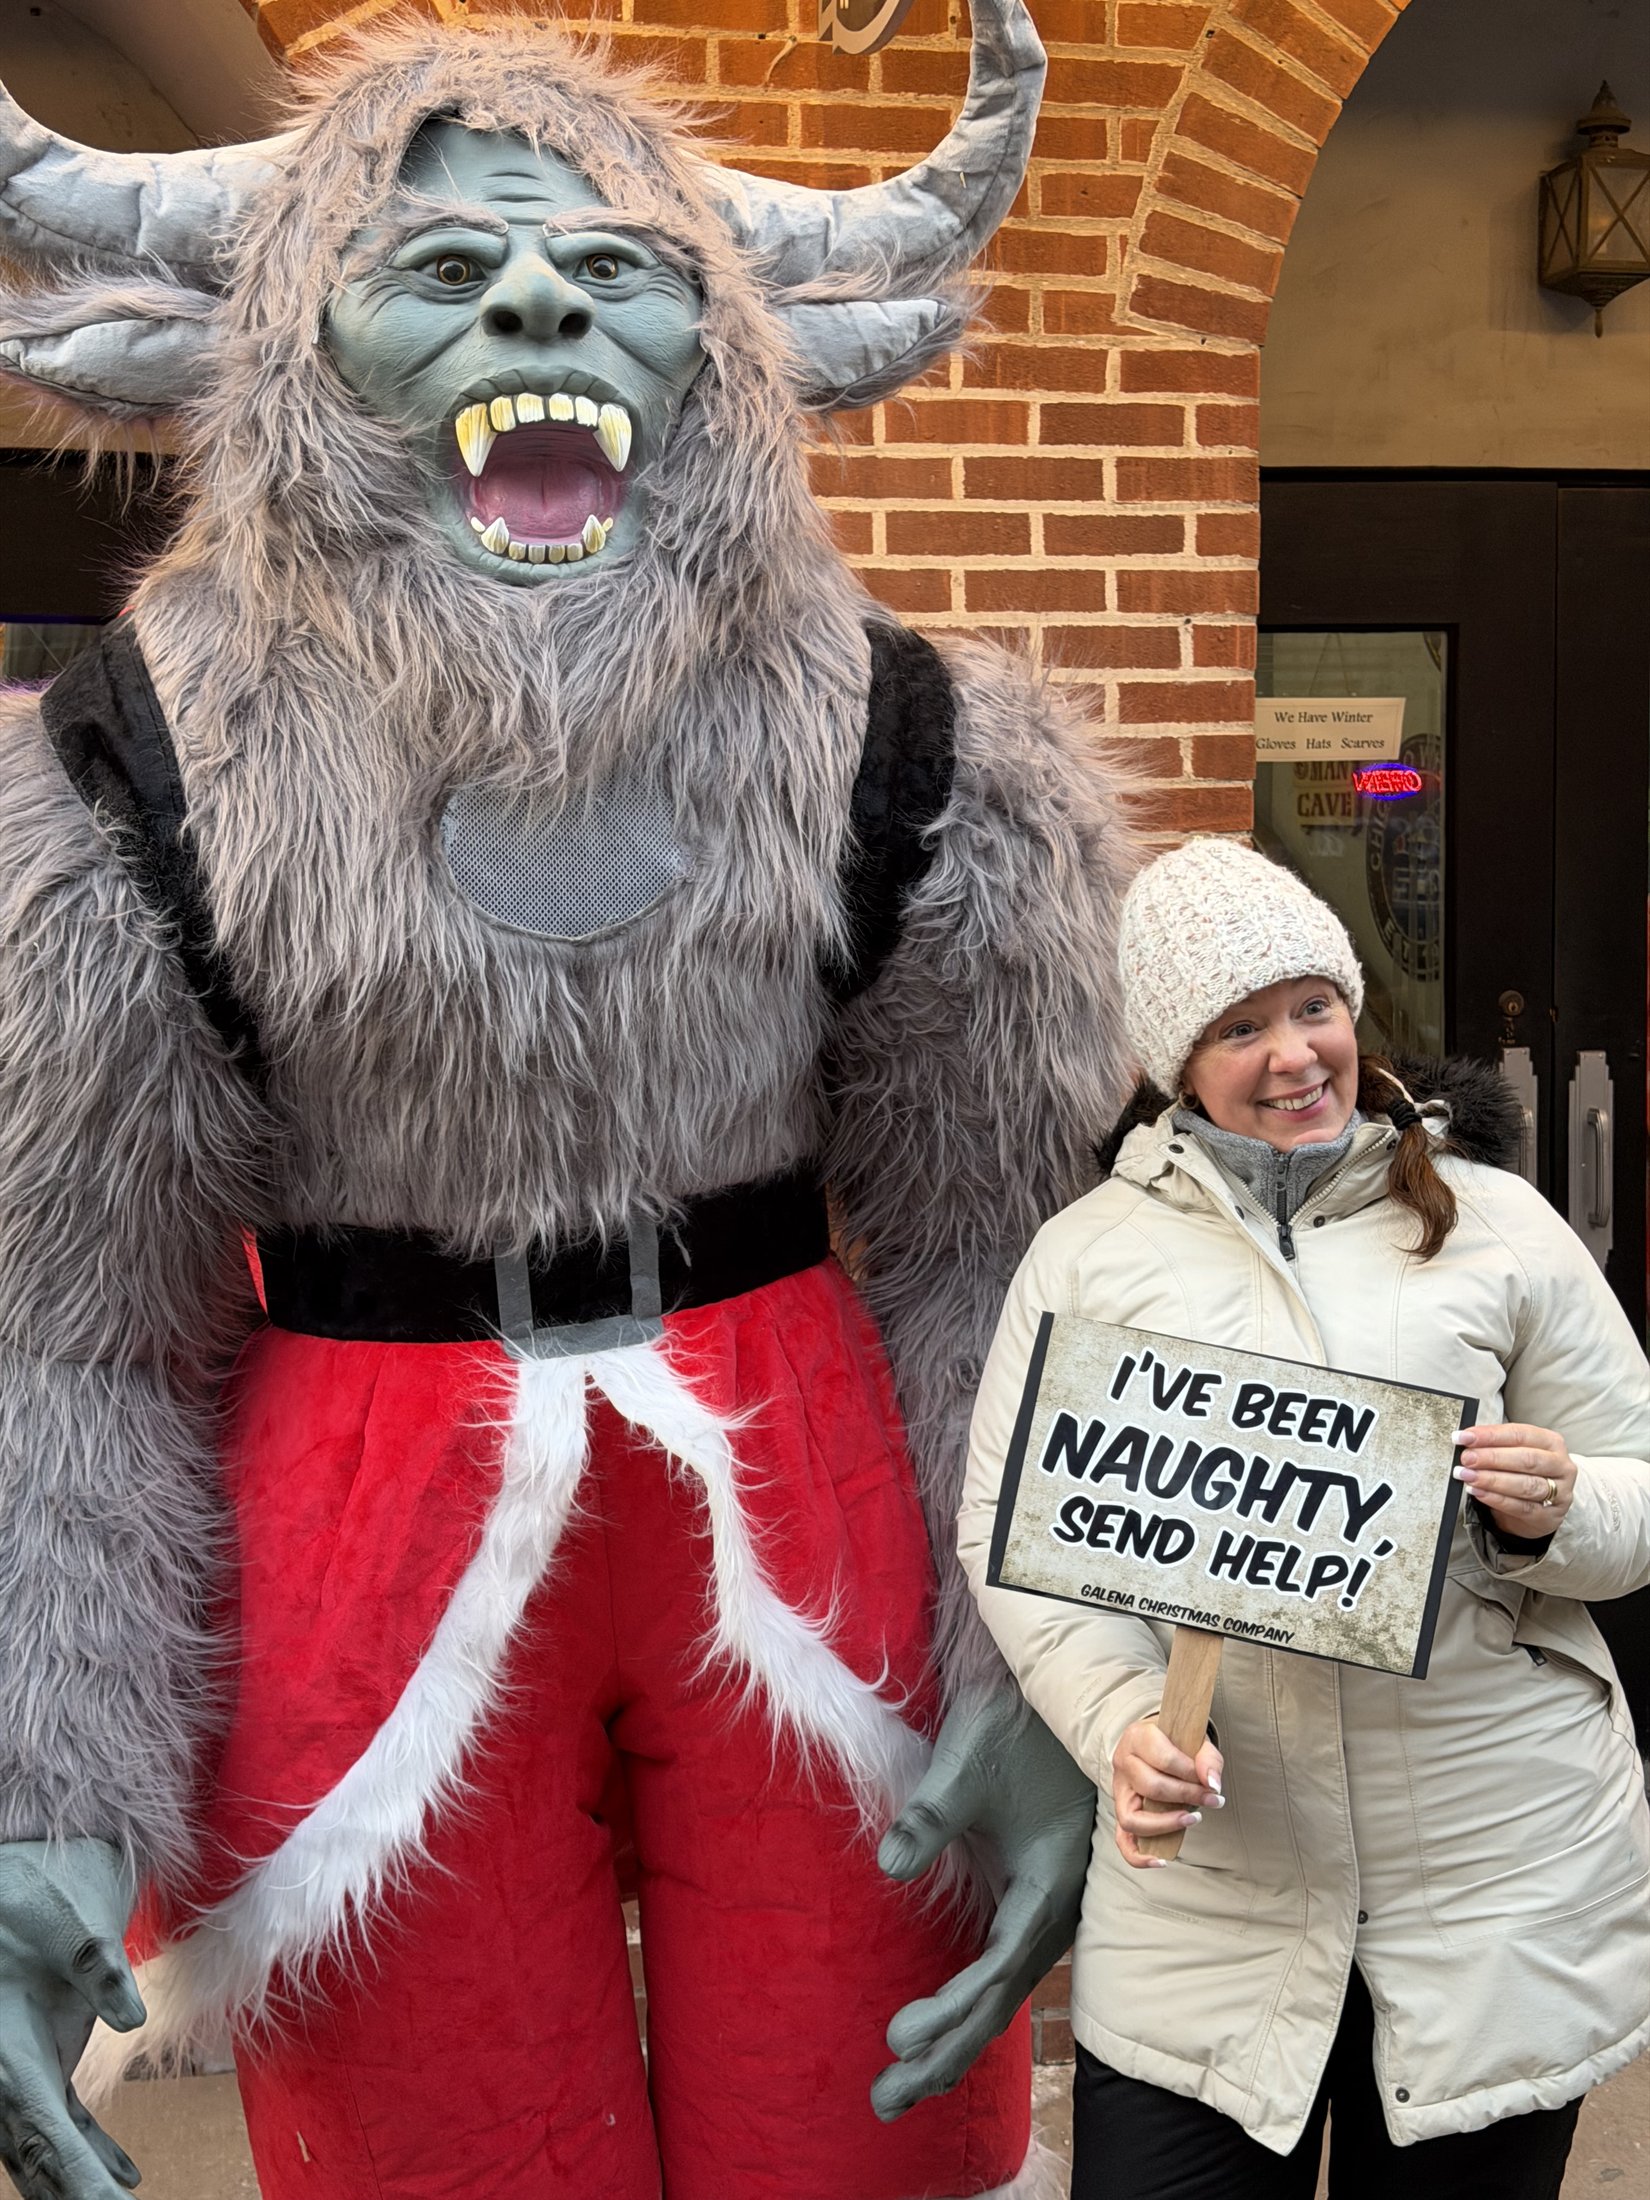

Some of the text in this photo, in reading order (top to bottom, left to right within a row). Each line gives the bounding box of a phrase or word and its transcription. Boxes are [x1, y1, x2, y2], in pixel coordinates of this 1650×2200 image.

[1255, 737, 1385, 750] Gloves Hats Scarves
[1274, 711, 1374, 723] We Have Winter
[1297, 792, 1352, 818] CAVE
[1110, 1350, 1376, 1453] I'VE BEEN
[1041, 1412, 1394, 1558] NAUGHTY,
[1053, 1495, 1372, 1609] SEND HELP!
[1080, 1583, 1295, 1645] GALENA CHRISTMAS COMPANY
